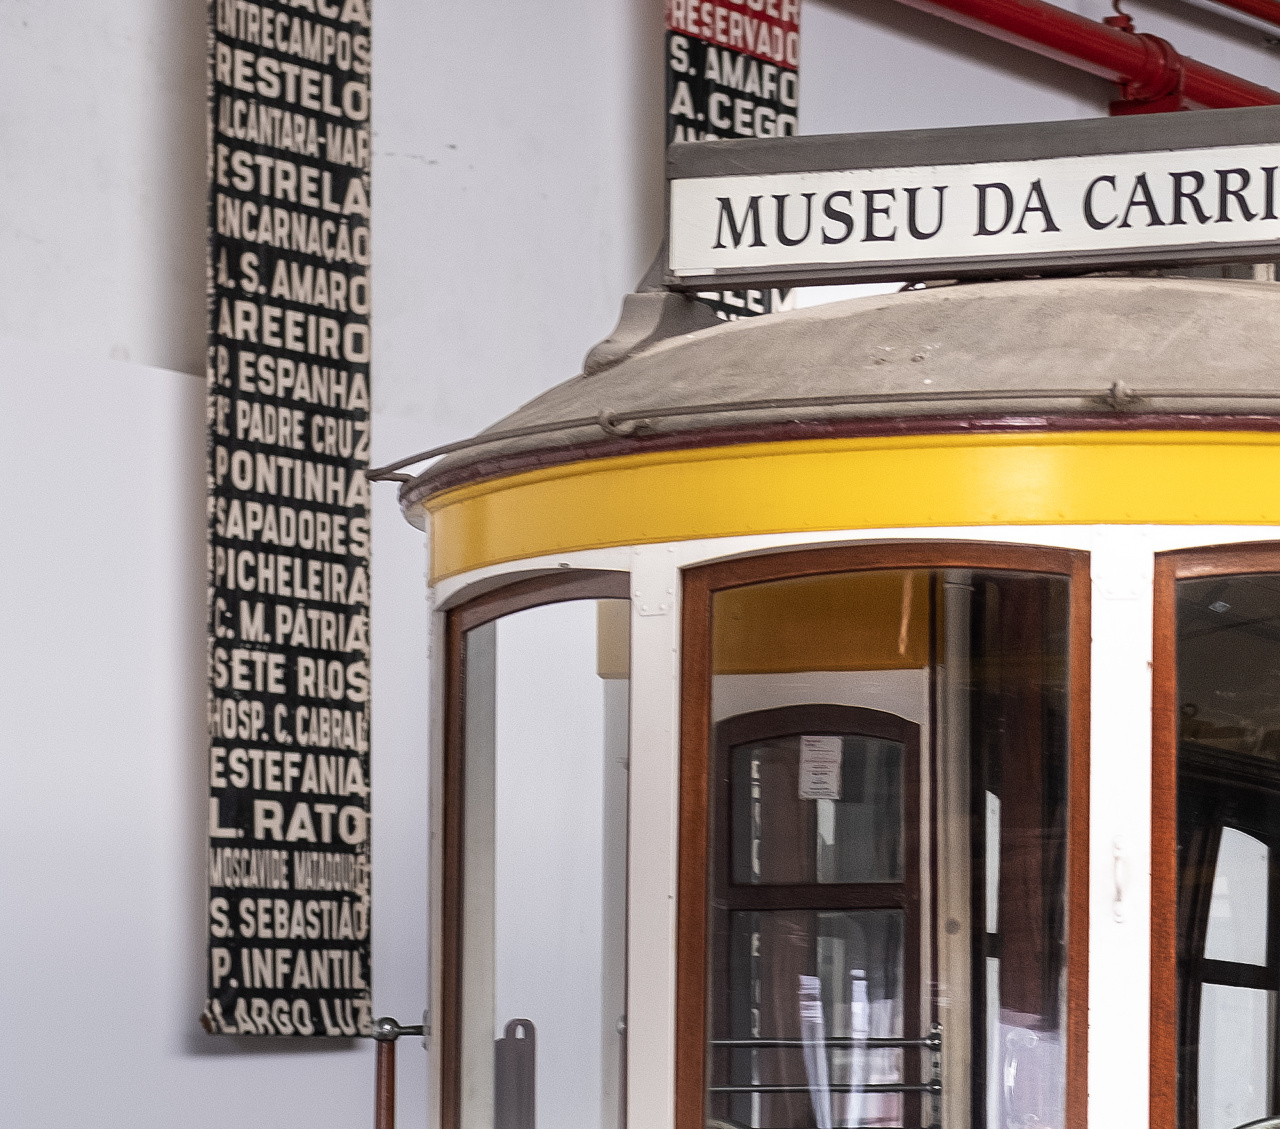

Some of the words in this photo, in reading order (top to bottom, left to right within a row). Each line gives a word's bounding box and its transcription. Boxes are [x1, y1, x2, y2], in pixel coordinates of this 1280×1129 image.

[670, 35, 697, 76] S.
[671, 0, 798, 66] RESERVADO
[216, 41, 370, 121] RESTELO
[669, 81, 705, 121] A.
[708, 92, 797, 138] CEGO
[216, 143, 370, 219] ESTRELA
[713, 186, 948, 249] MUSEU
[974, 178, 1060, 235] DA
[270, 258, 370, 315] AMARO
[217, 297, 370, 363] AREEIRO
[238, 350, 370, 411] ESPANHA
[236, 400, 305, 450] PADRE
[311, 414, 370, 461] CRUZ
[215, 445, 370, 509] PONTINHA
[239, 600, 271, 643] M.
[214, 647, 286, 694] SETE
[297, 655, 370, 703] RIOS
[209, 797, 244, 838] L.
[254, 799, 367, 845] RATO
[241, 948, 366, 989] INFANTIL
[212, 997, 314, 1036] LARGO
